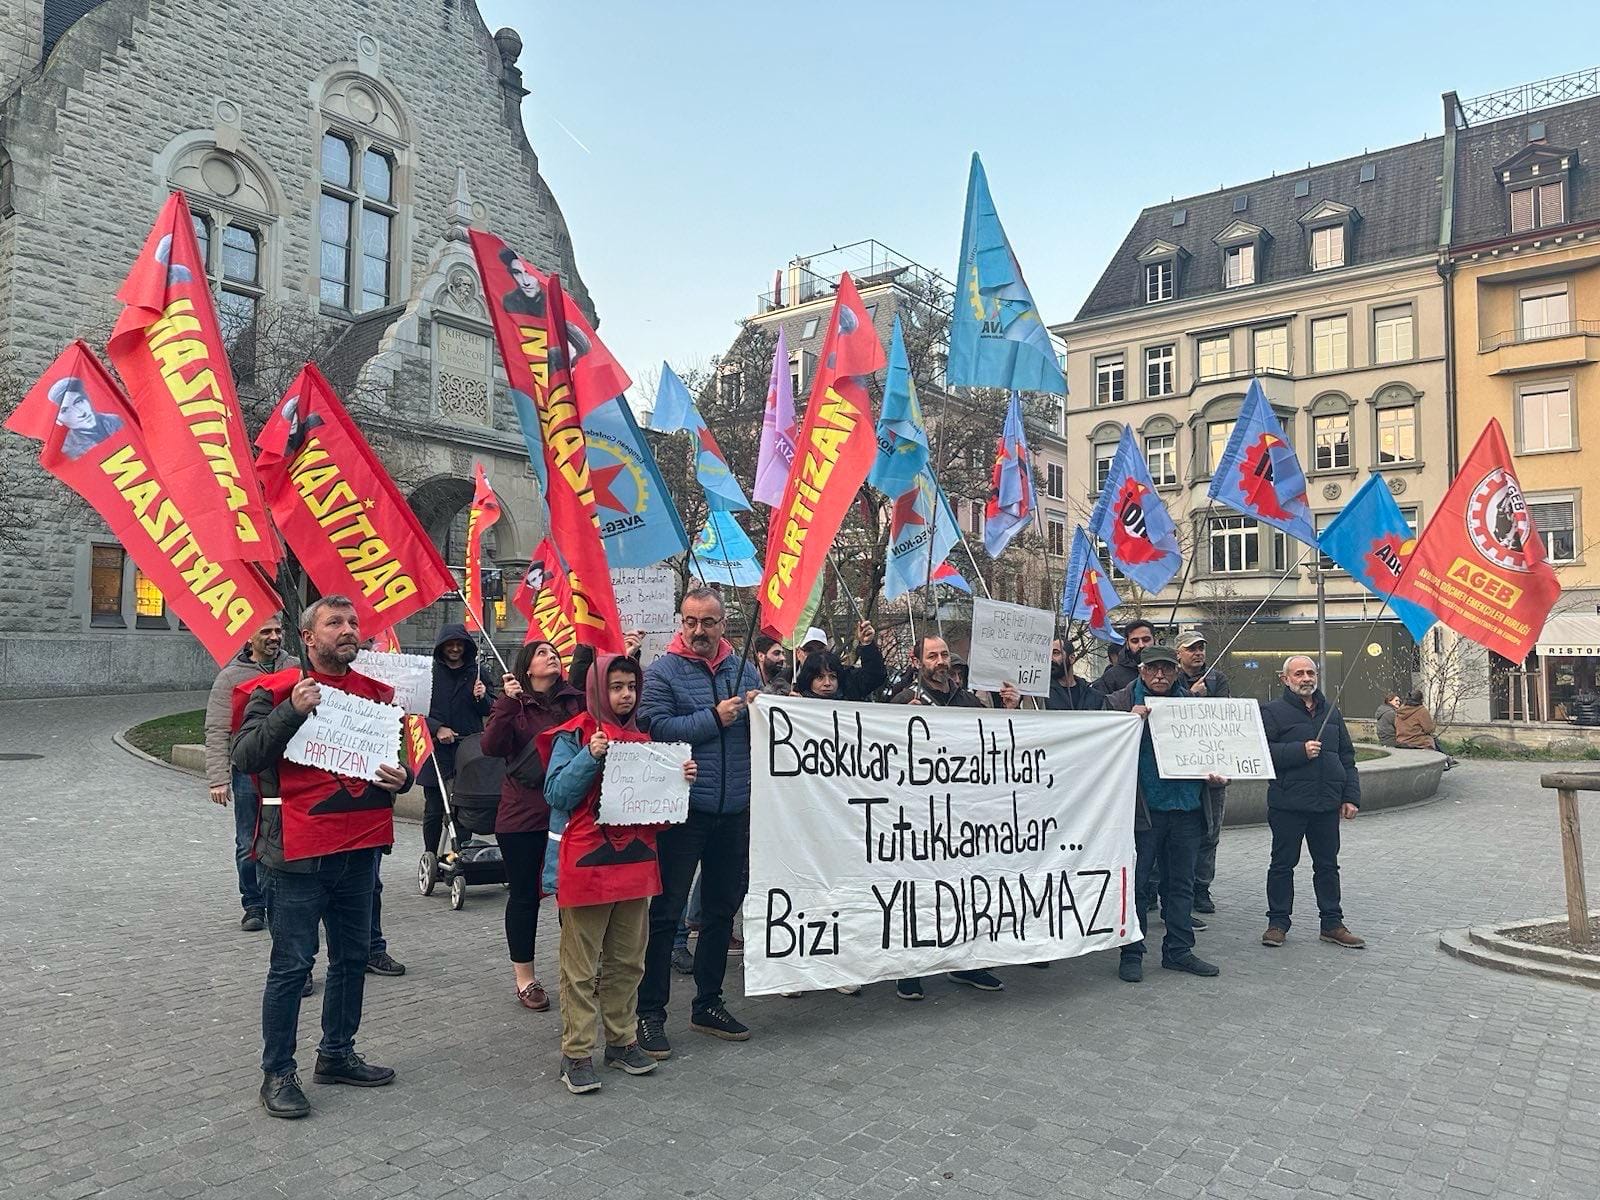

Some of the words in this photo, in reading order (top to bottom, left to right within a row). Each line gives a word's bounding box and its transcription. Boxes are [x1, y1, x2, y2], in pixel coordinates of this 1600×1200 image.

[445, 327, 481, 346] KIRCHE
[1451, 563, 1515, 603] AGEB
[766, 888, 840, 959] Bizi
